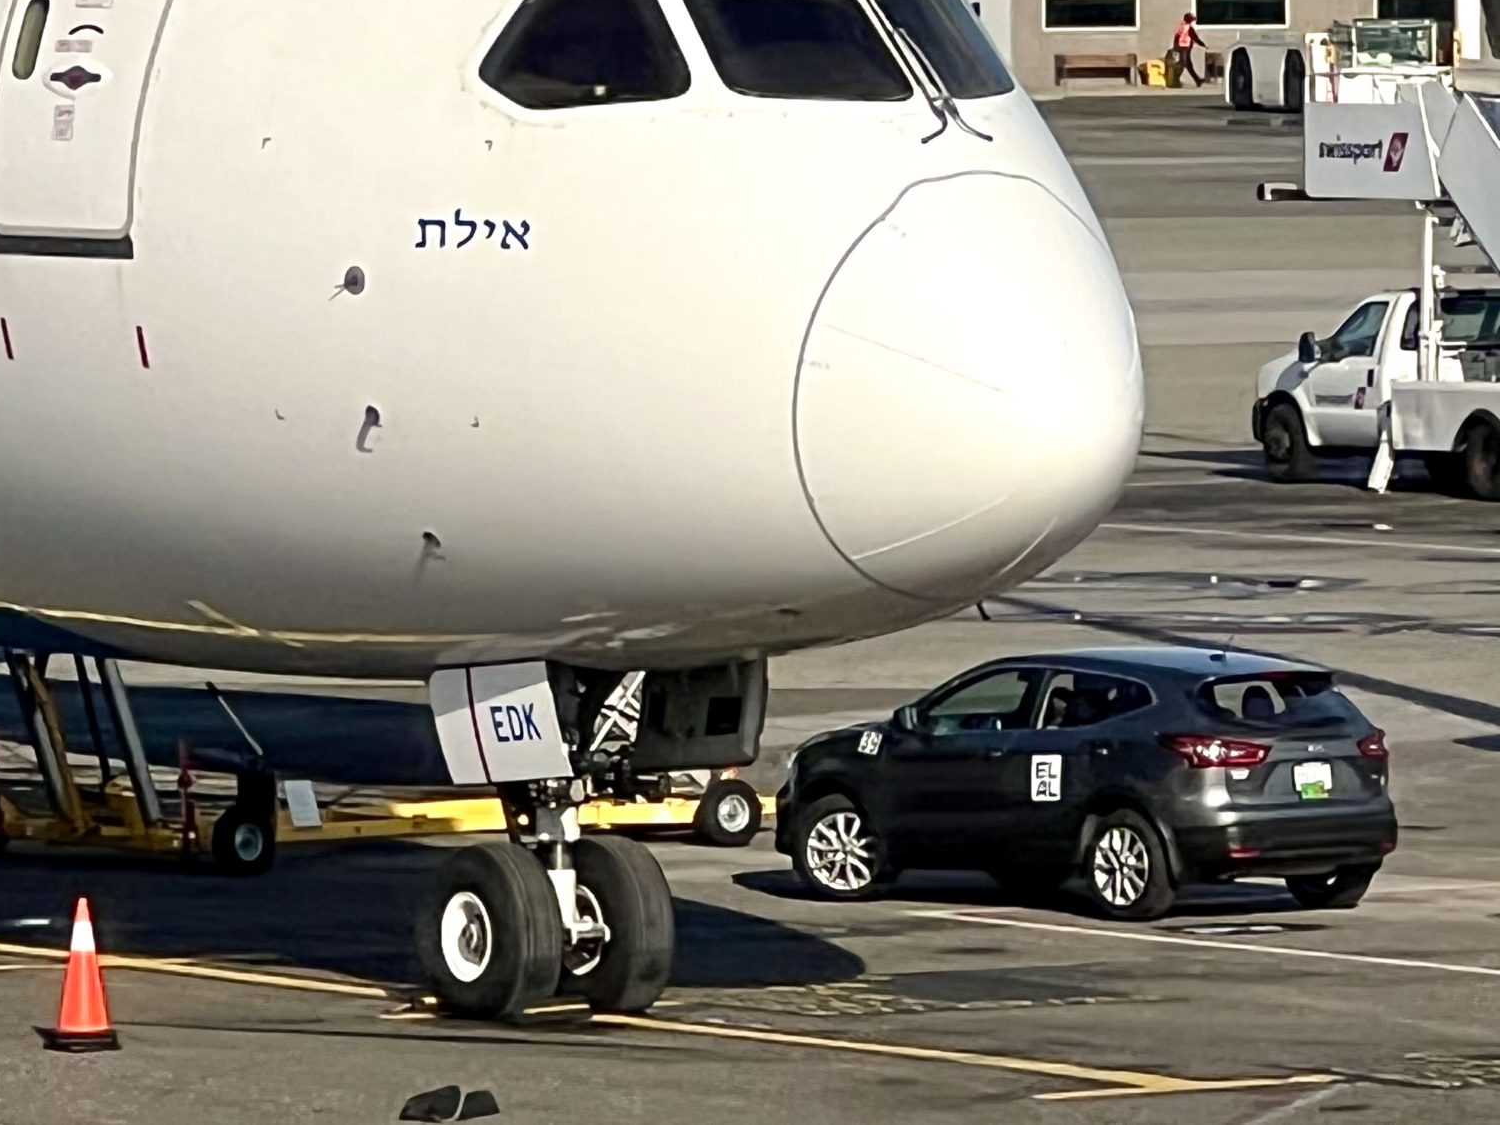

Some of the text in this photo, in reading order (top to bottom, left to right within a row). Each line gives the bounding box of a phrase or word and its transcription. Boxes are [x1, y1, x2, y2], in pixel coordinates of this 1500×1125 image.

[414, 208, 531, 251] אילת
[489, 702, 542, 743] EDK
[1035, 761, 1058, 779] EL
[1035, 780, 1058, 797] AL
